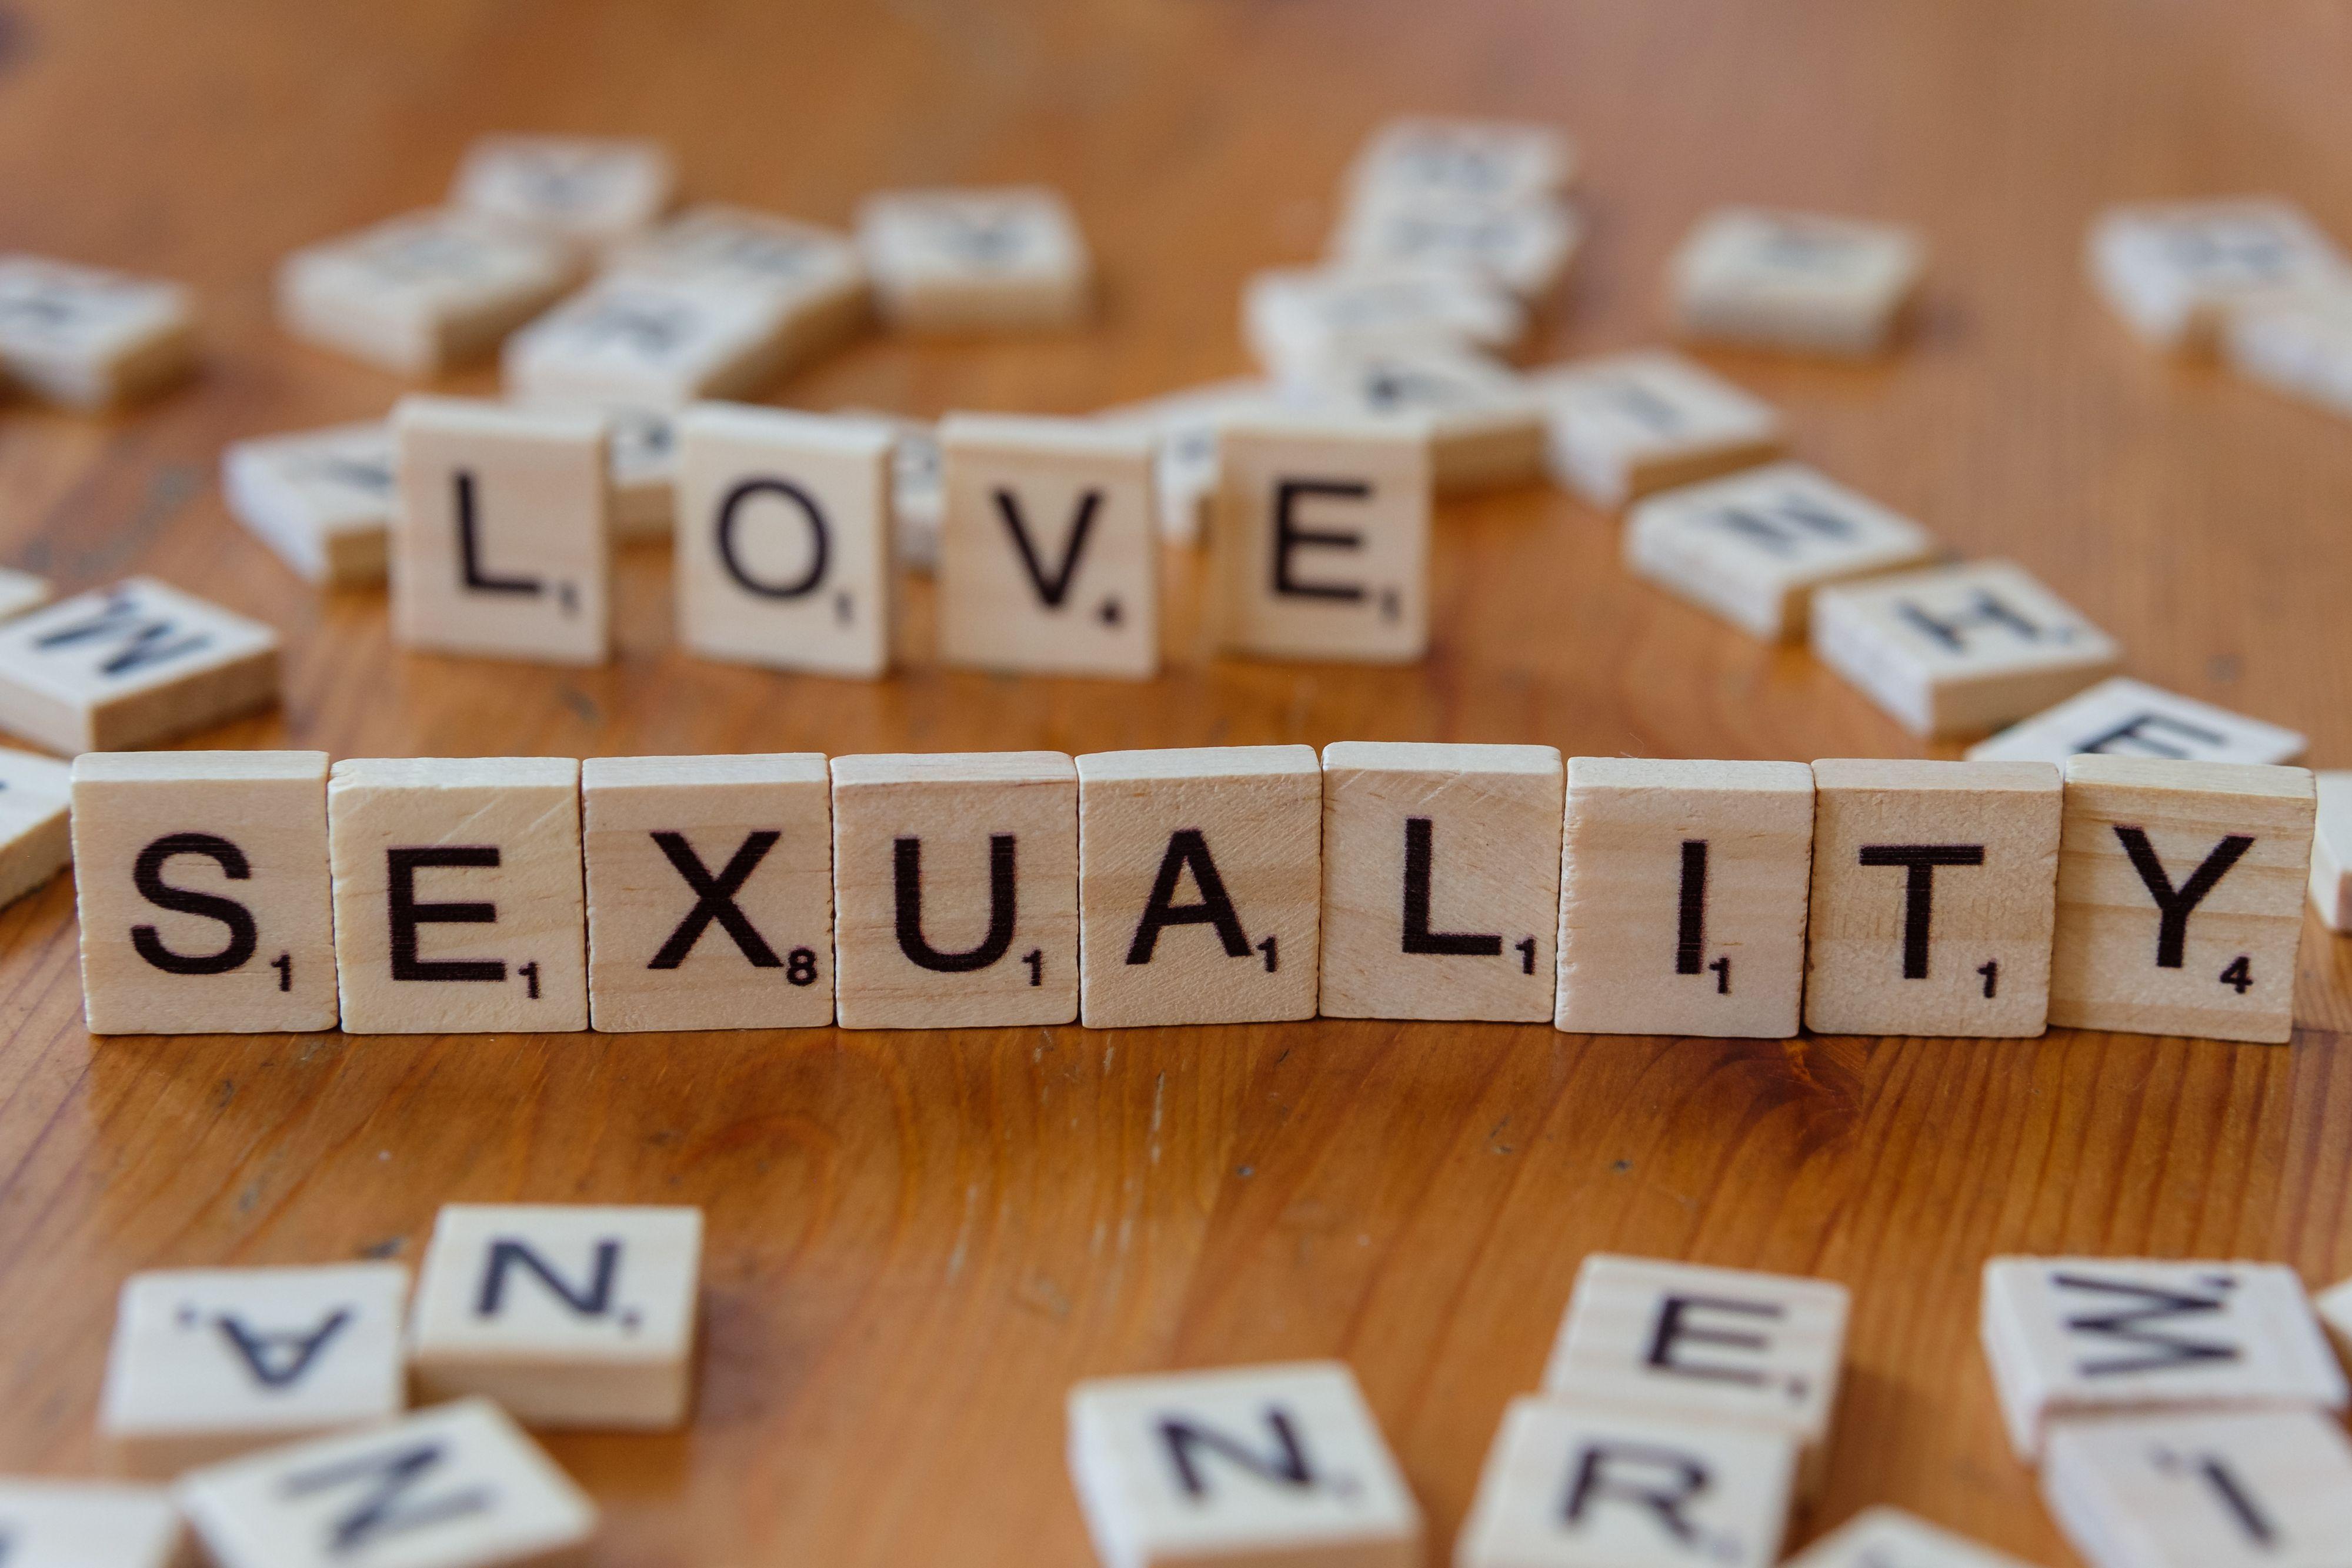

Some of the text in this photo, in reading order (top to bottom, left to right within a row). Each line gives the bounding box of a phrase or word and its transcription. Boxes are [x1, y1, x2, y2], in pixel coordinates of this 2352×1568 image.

[130, 818, 2256, 982] SEXUALITY
[271, 954, 292, 992] 1
[786, 947, 819, 987] 8
[1021, 949, 1045, 987] 1
[1255, 935, 1280, 973] 1
[1514, 937, 1537, 976] 1
[517, 961, 541, 1000] 1
[1707, 957, 1732, 996] 1
[1976, 960, 1999, 999] 1
[2219, 956, 2254, 995] 4
[478, 1237, 623, 1319] N
[213, 1303, 356, 1389] A
[1644, 1293, 1788, 1387] E
[1156, 1403, 1315, 1499] N
[1559, 1440, 1709, 1544] R
